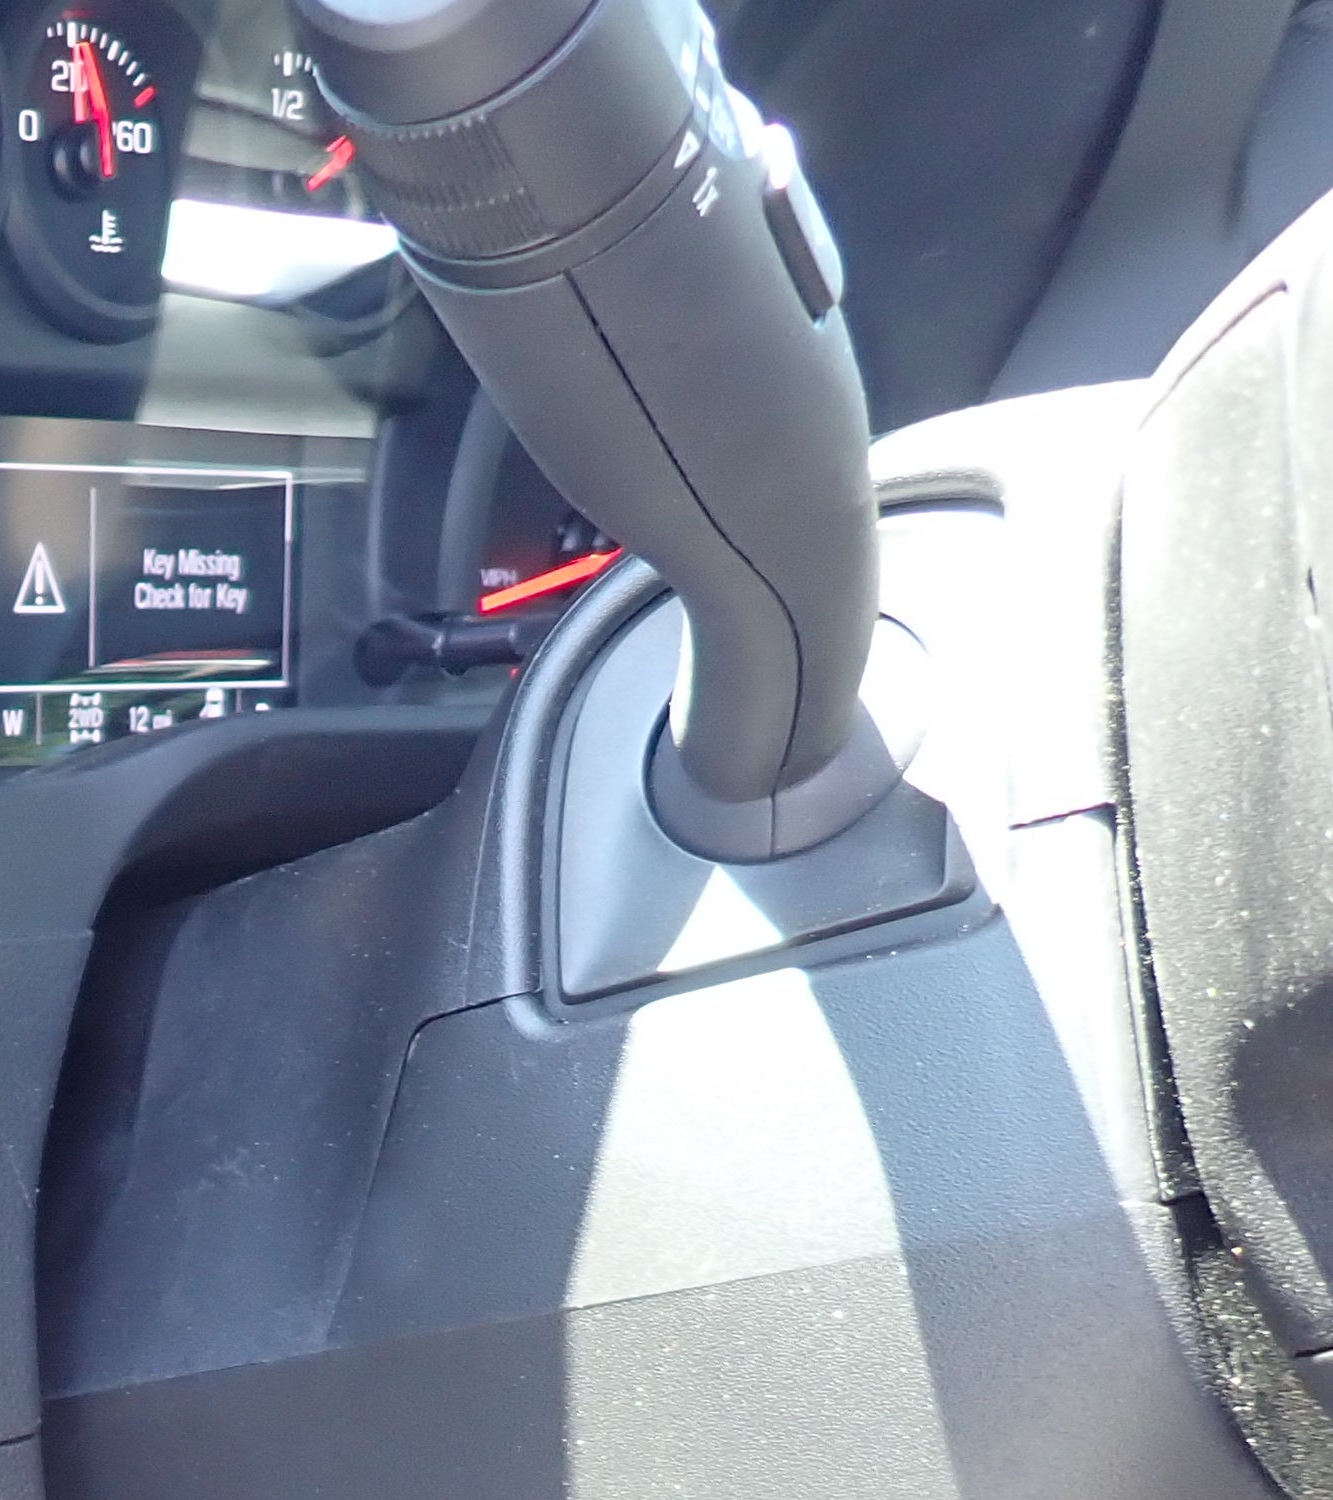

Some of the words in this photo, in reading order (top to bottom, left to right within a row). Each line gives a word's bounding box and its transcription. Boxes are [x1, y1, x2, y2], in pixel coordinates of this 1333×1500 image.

[271, 88, 305, 120] 1/2
[143, 549, 175, 580] Key
[178, 549, 241, 580] Missing
[134, 582, 185, 609] Check
[187, 583, 212, 609] for
[215, 584, 248, 613] Key
[2, 708, 24, 736] W
